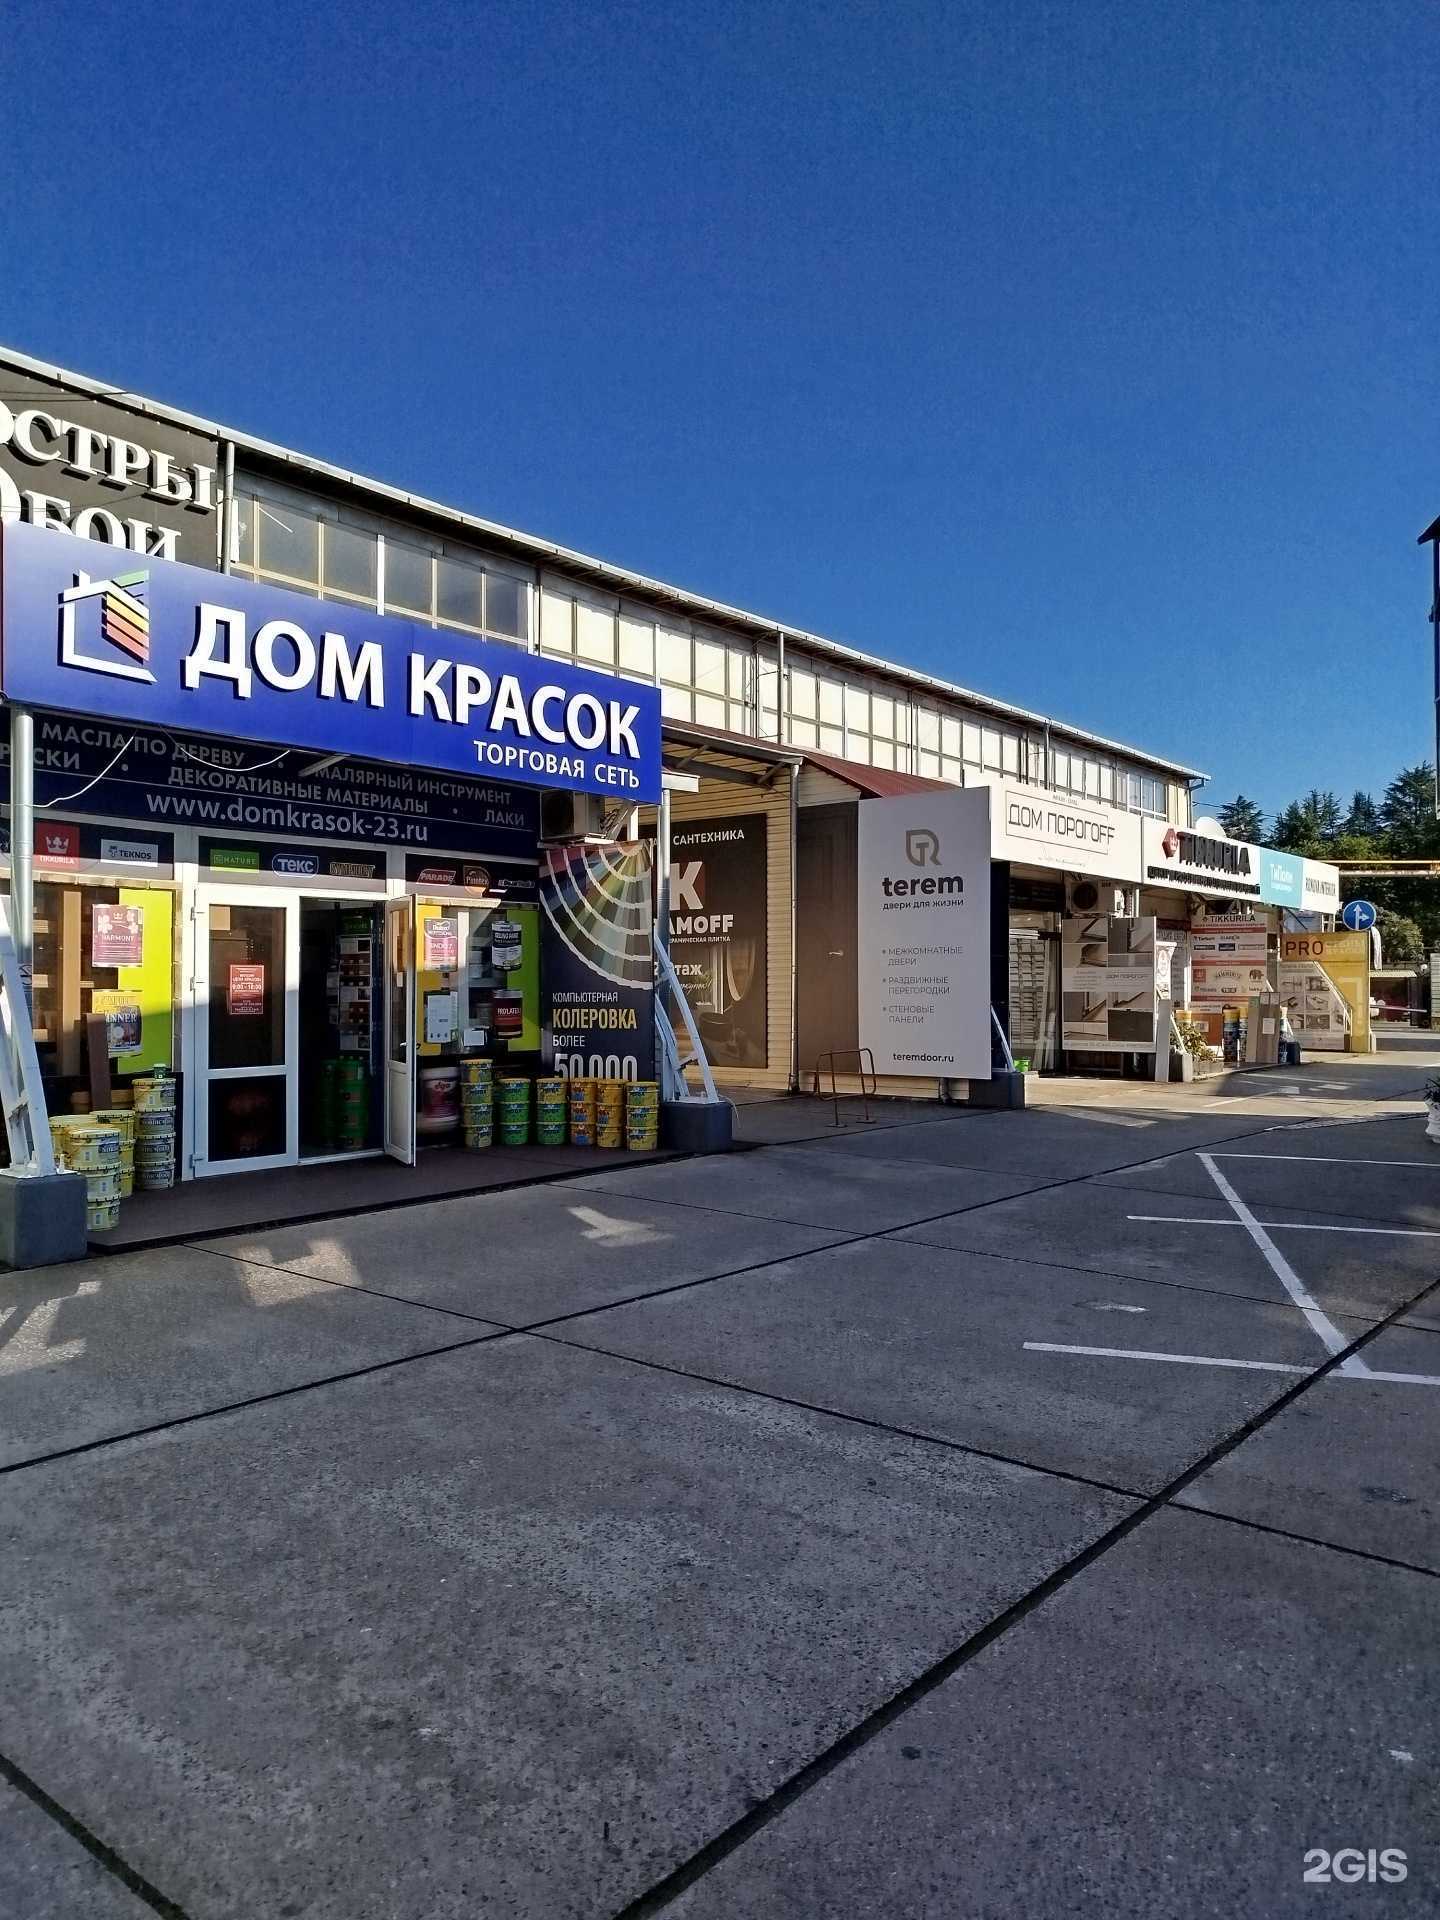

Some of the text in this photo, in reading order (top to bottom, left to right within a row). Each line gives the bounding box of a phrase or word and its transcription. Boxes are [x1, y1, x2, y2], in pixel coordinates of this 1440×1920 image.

[0, 401, 216, 510] СТРЫ
[0, 468, 181, 562] БОИ
[184, 602, 641, 759] ДОМ КРАСОК
[42, 723, 512, 806] МАСЛА ПО ДЕРЕВУ МАЛЯРНЫЙ ИНСТРУМЕНТ
[473, 740, 641, 789] ТОРГОВАЯ СЕТЬ
[0, 743, 525, 826] РСКИ ДЕКОРАТИВНЫЕ МАТЕРИАЛЫ ЛАКИ
[146, 794, 429, 842] www.domkrasok-23.ru
[1008, 803, 1043, 831] ДОМ
[672, 829, 745, 846] САНТЕХНИКА
[118, 849, 153, 860] TEKNOS
[882, 876, 964, 897] terem
[913, 901, 930, 909] для
[932, 899, 964, 907] жизни
[1210, 914, 1256, 923] TIKKURILA
[888, 946, 963, 955] МЕЖКОМНАТНЫЕ
[1285, 941, 1324, 956] PRO
[888, 958, 917, 966] ДВЕРИ
[888, 976, 949, 985] РАЗДВИЖНЫЕ
[552, 992, 619, 1003] КОМПЬЮТЕРНАЯ
[888, 986, 950, 996] ПЕРЕГОРОДКИ
[888, 1005, 935, 1014] СТЕНОВЫЕ
[552, 1008, 638, 1030] КОЛЕРОВКА
[888, 1016, 924, 1024] ПАНЕЛИ
[552, 1034, 585, 1047] БОЛЕЕ
[893, 1053, 954, 1063] teremdoor.ru
